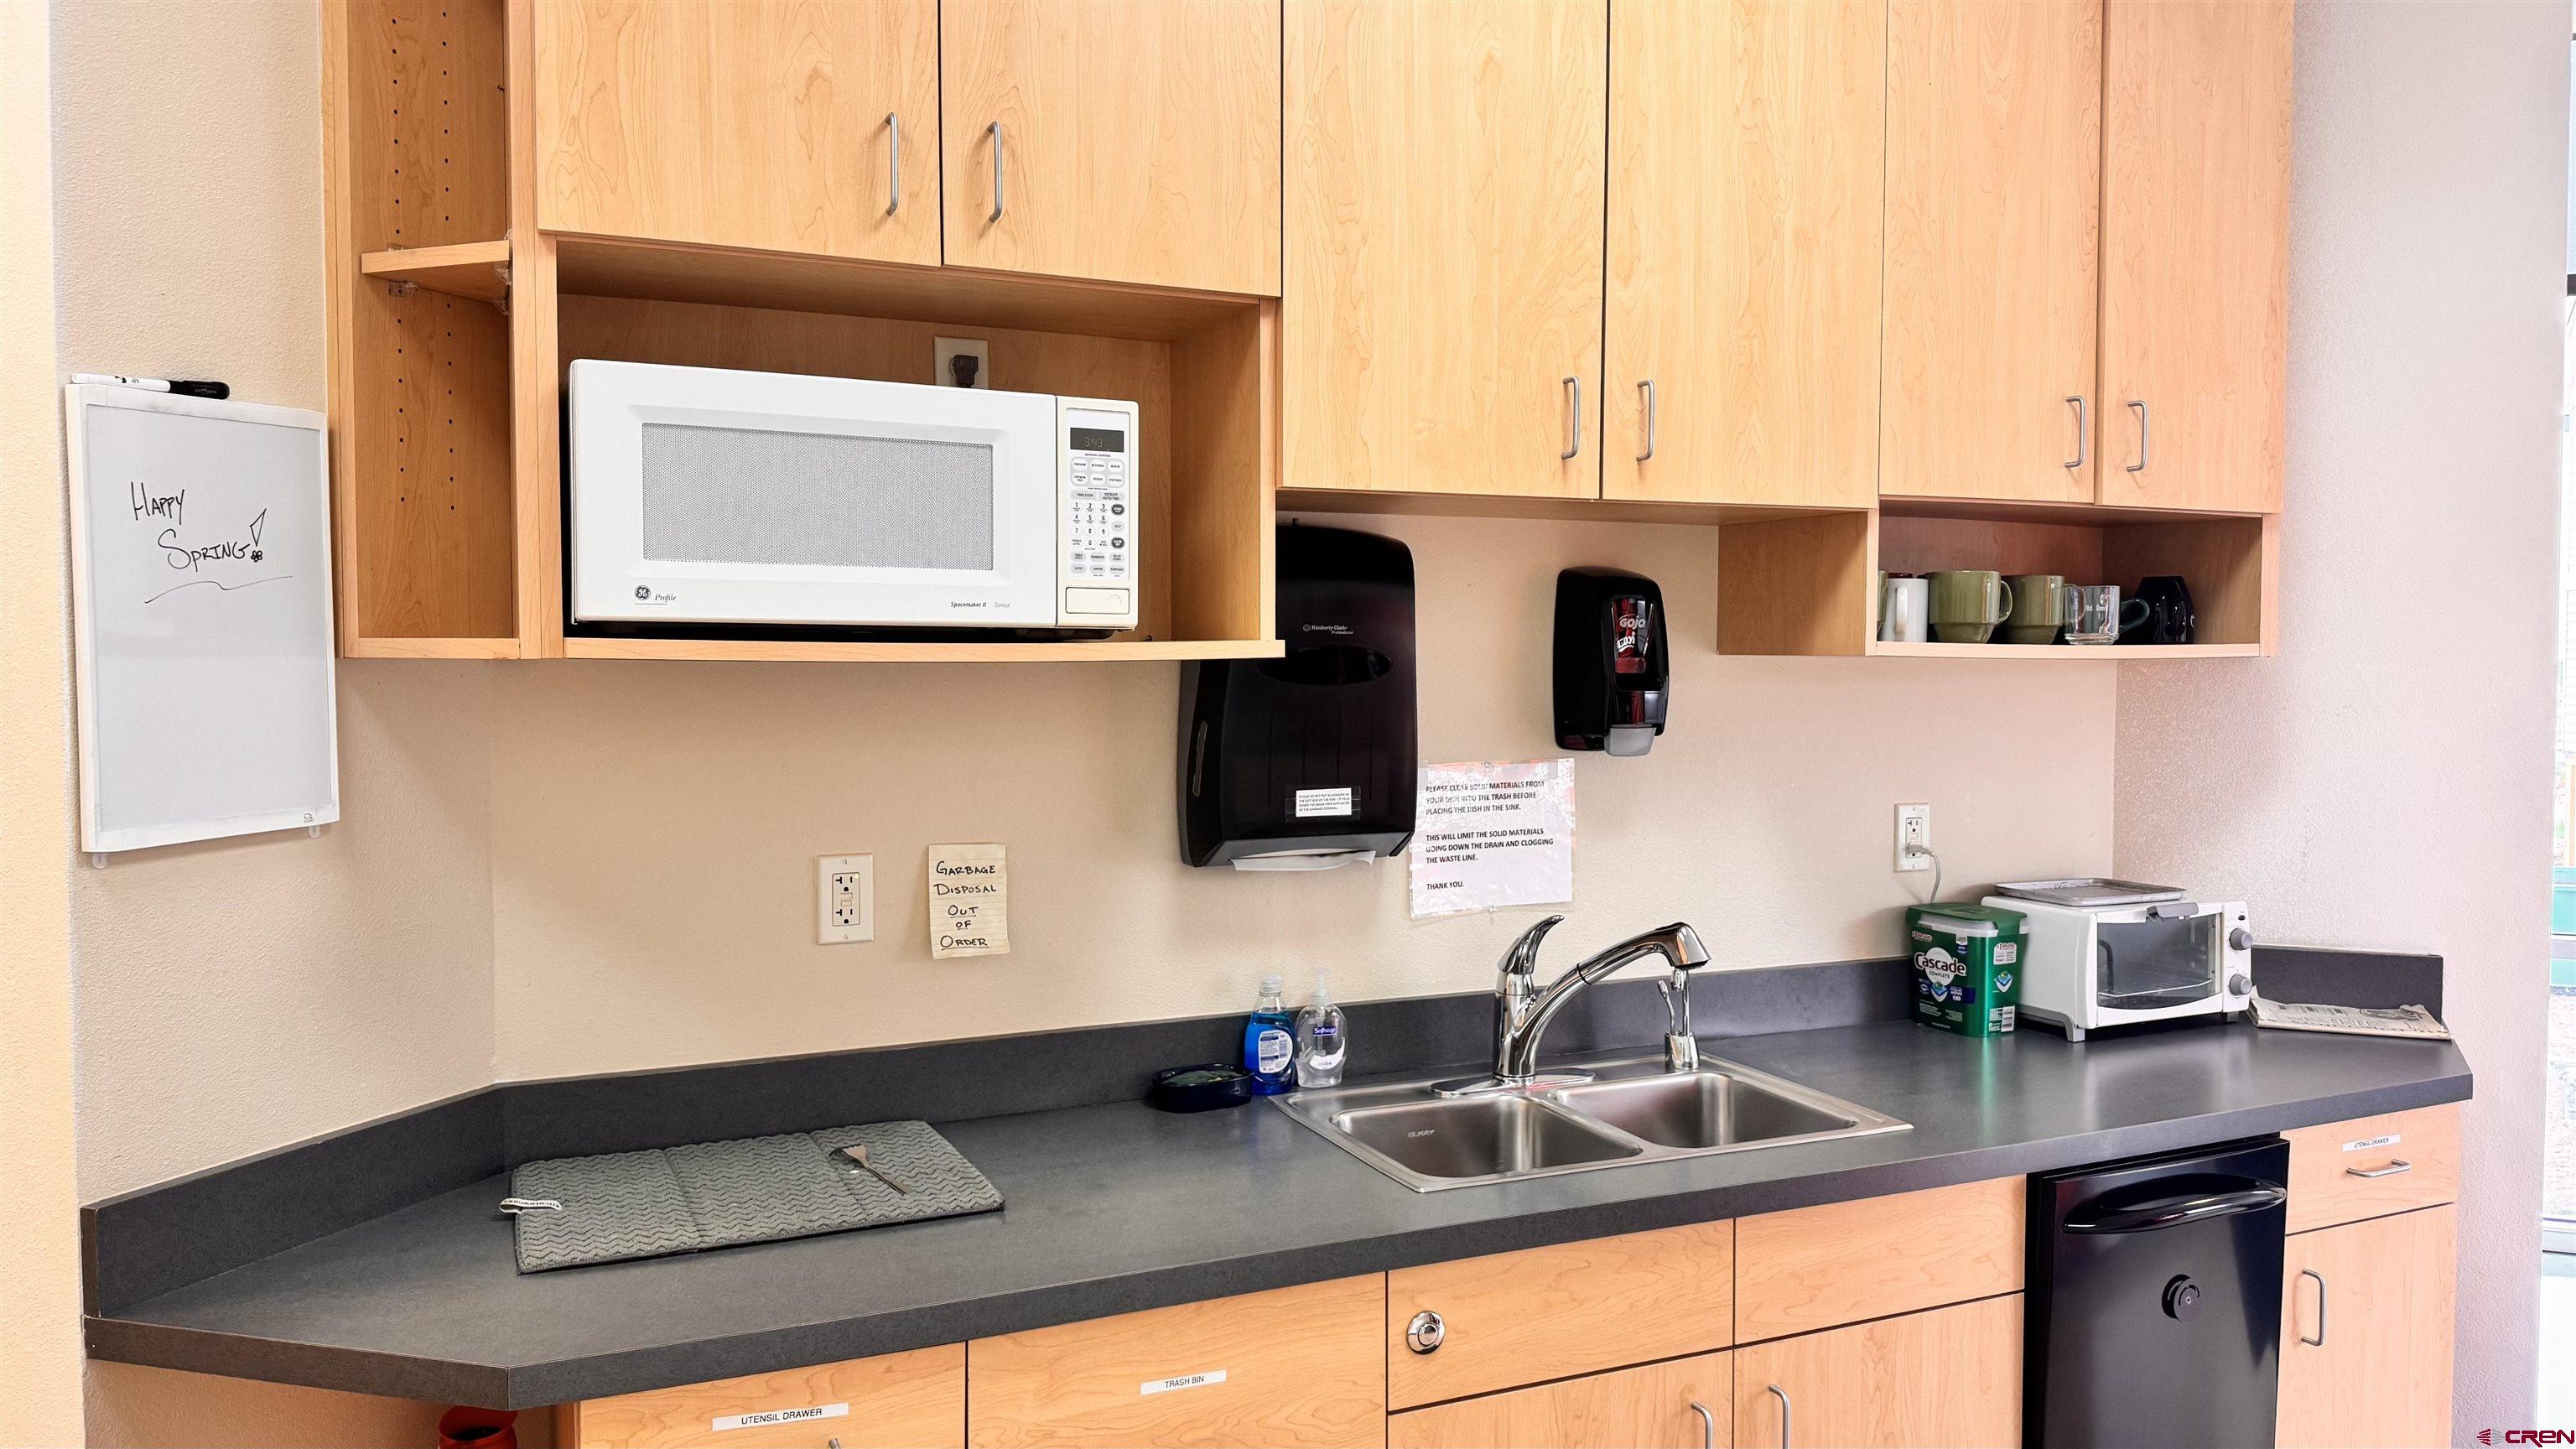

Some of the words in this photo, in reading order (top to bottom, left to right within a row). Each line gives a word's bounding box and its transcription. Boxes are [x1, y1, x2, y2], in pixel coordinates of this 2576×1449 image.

[655, 594, 677, 603] Profile
[1488, 782, 1524, 790] MATERIALS
[1426, 796, 1444, 804] YOUR
[1426, 807, 1453, 815] PLACING
[1509, 828, 1544, 836] MATERIALS
[1426, 844, 1447, 853] GOING
[1520, 838, 1554, 846] CLOGGING
[1439, 854, 1462, 863] WASTE
[936, 860, 996, 875] GARBAGE
[933, 883, 997, 896] DISPOSAL
[948, 905, 979, 916] OUT
[940, 935, 988, 948] ORDER
[1914, 953, 1966, 975] Cascade
[1929, 970, 1950, 979] COMPLETE
[1165, 1377, 1190, 1388] TRASH
[1192, 1375, 1204, 1384] BIN
[741, 1413, 780, 1425] UTENSIL
[782, 1408, 823, 1420] DRAWER
